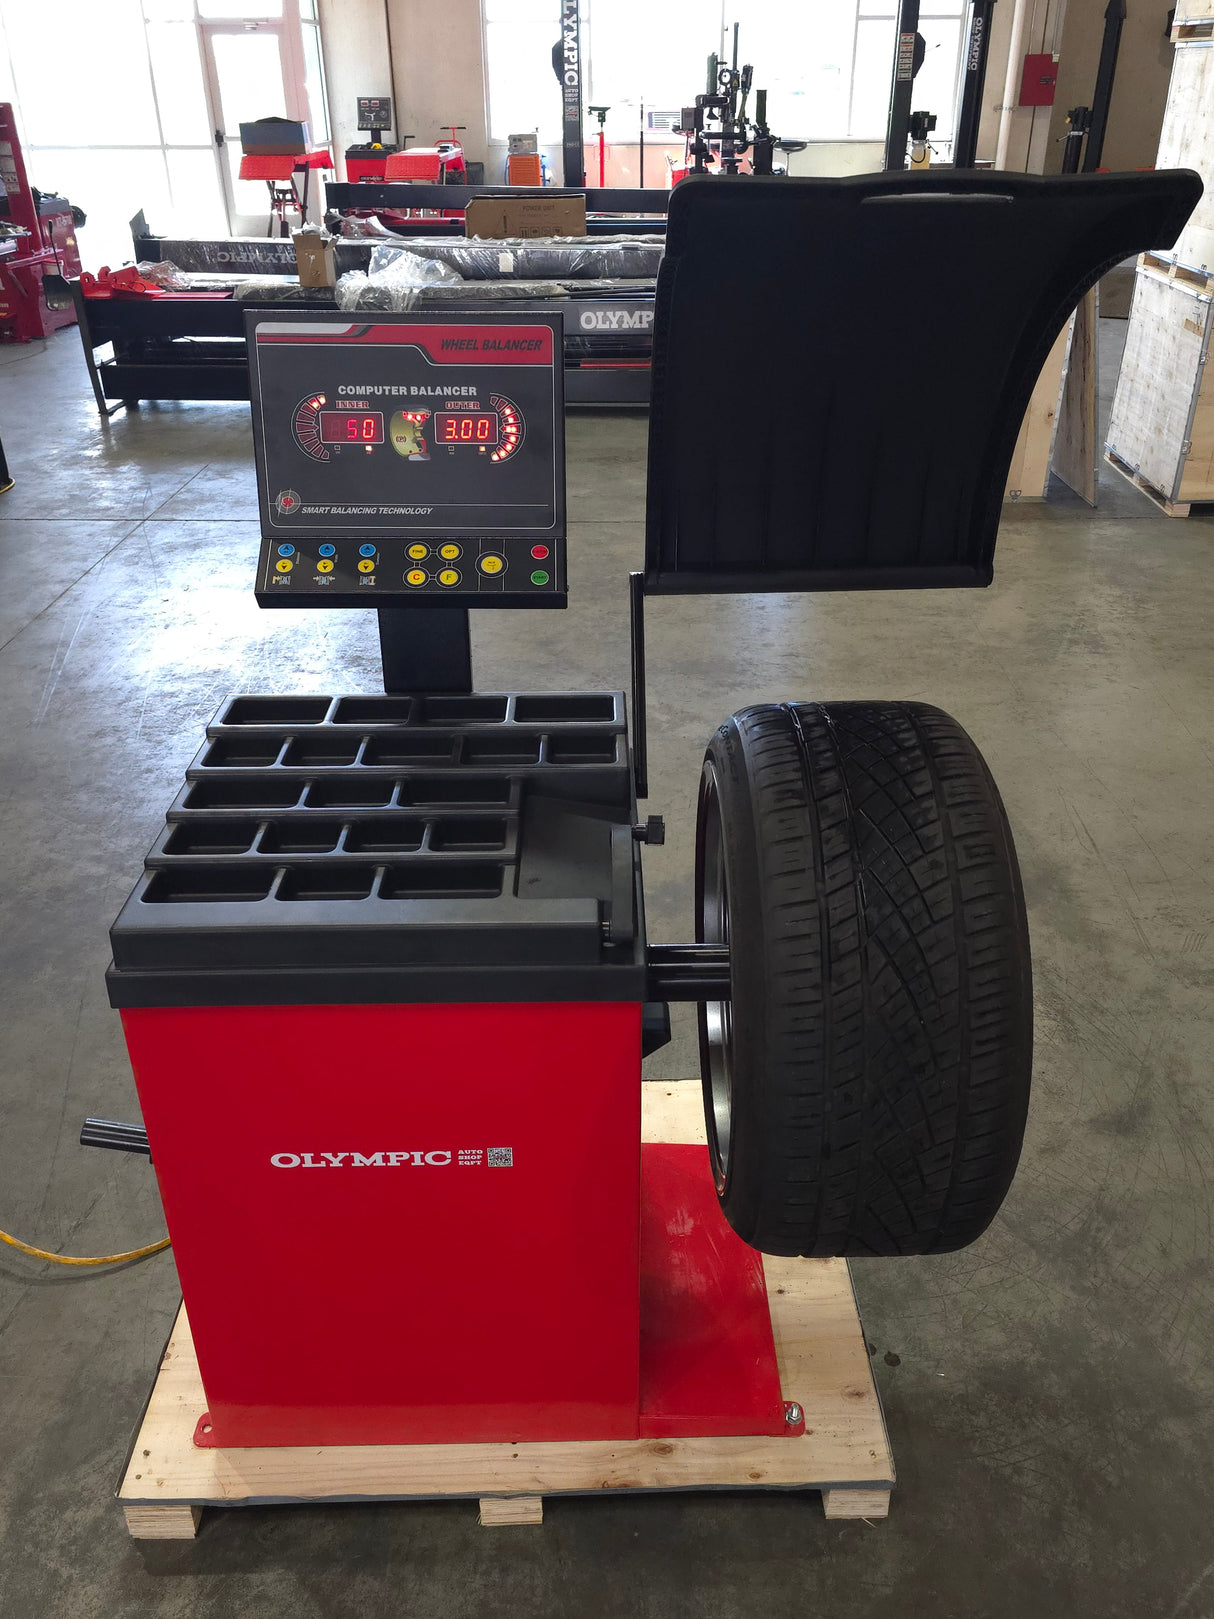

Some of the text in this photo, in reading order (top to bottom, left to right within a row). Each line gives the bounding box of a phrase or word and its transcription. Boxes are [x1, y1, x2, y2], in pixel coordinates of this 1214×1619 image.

[563, 0, 579, 86] LYMPIC
[580, 311, 654, 329] OLYMP
[440, 339, 542, 351] WHEEL BALANCER
[338, 385, 478, 396] COMPUTER BALANCER
[335, 400, 370, 409] INNER
[445, 401, 481, 410] OUTER
[347, 418, 375, 439] 50
[445, 419, 490, 440] 3.00
[301, 506, 433, 515] SMART BALANCING TECHNOLOGY
[413, 573, 420, 581] C
[446, 573, 453, 581] F
[270, 1150, 451, 1168] OLYMPIC
